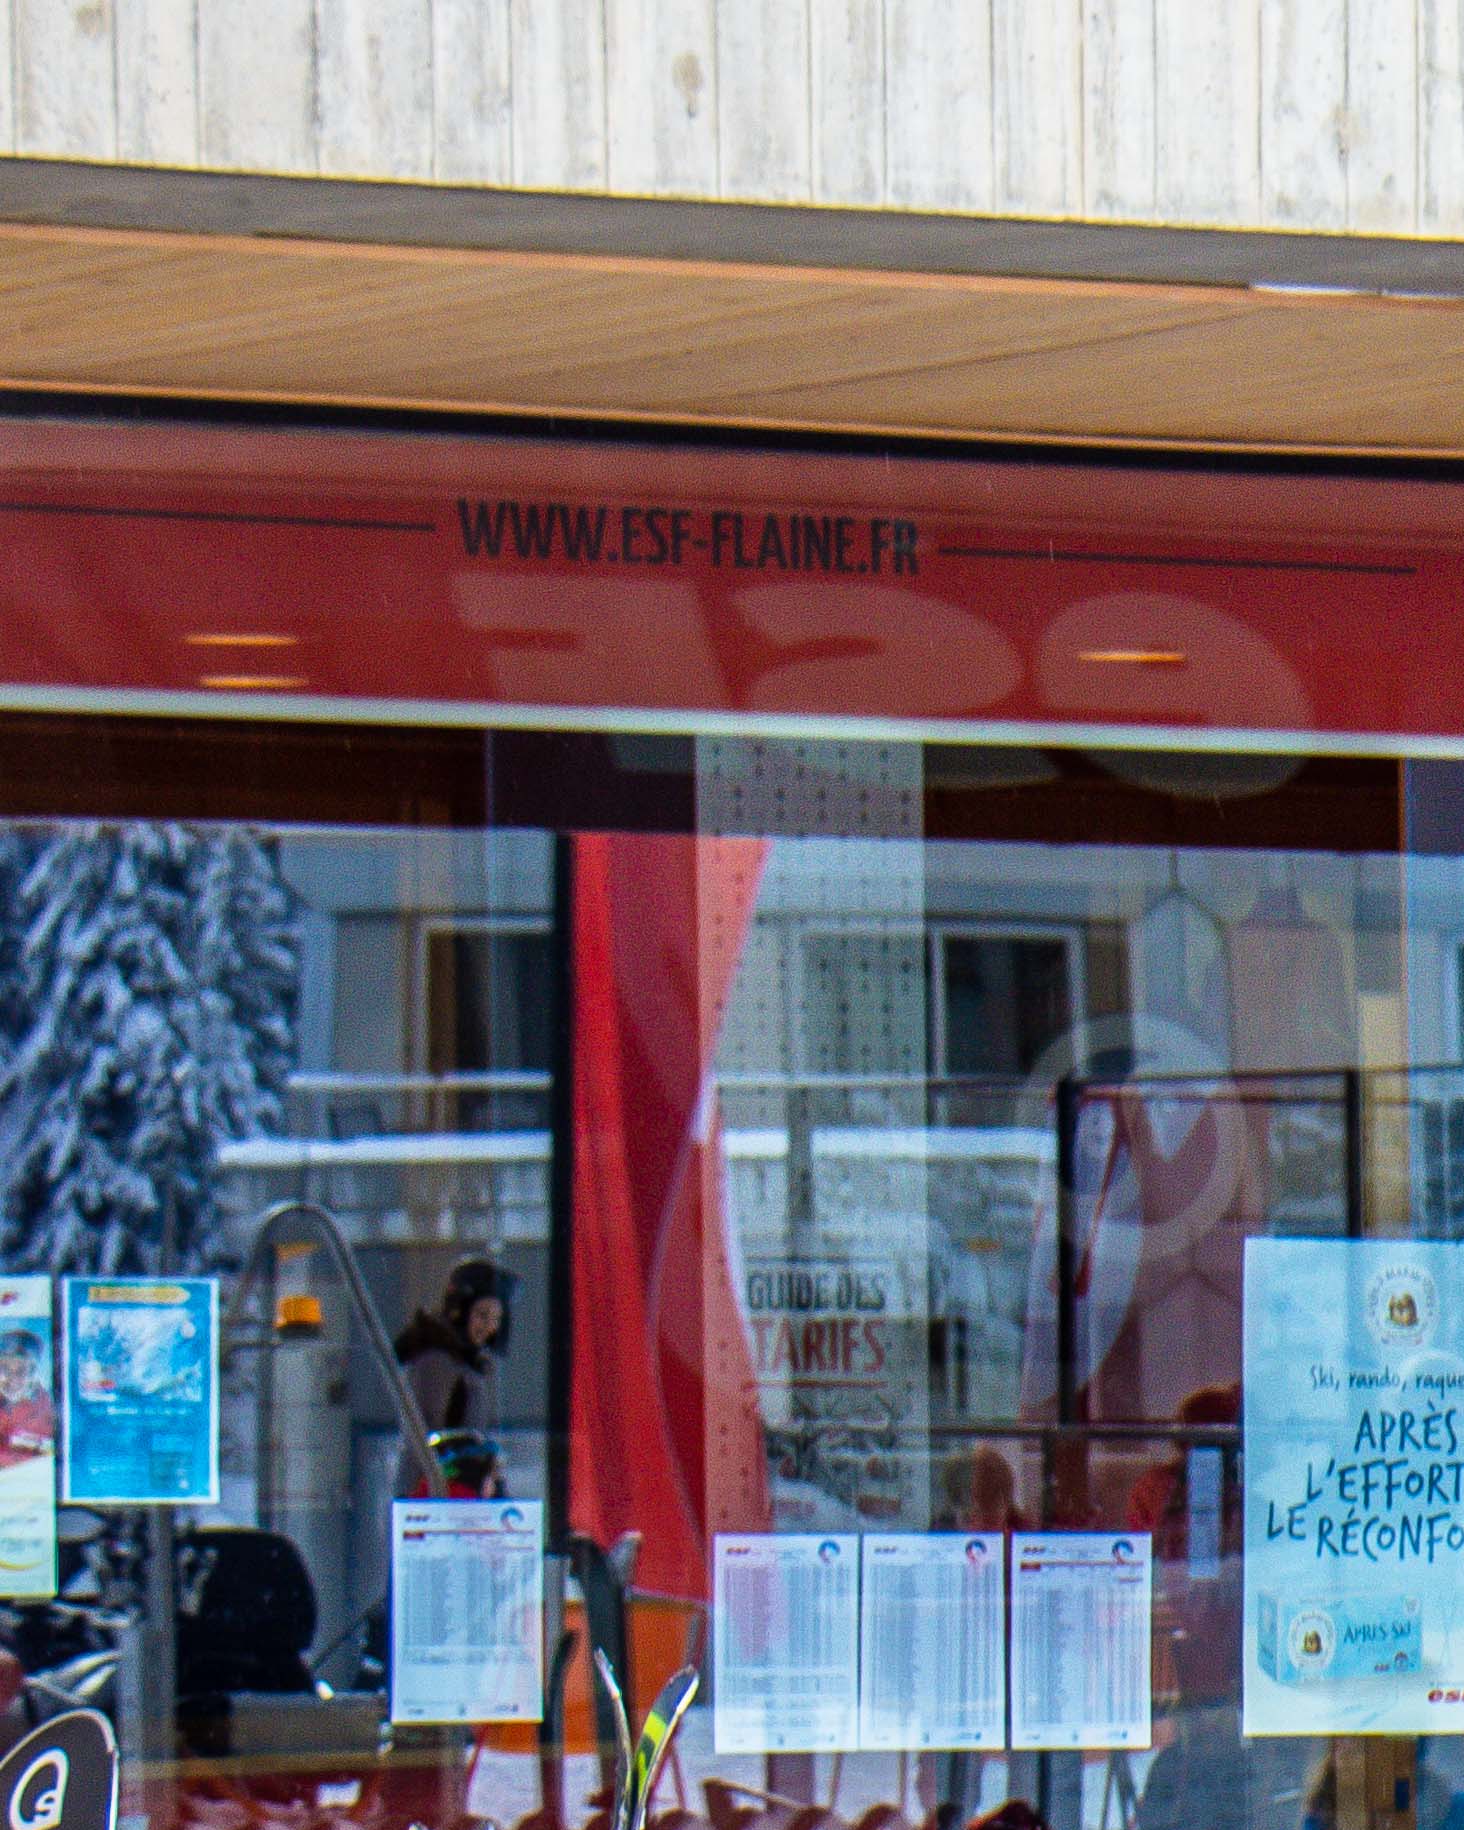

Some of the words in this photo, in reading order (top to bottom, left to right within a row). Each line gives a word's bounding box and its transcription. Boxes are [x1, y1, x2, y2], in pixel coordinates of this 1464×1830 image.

[459, 499, 920, 577] WWW.ESF-FLAINE.FR
[746, 1270, 835, 1312] GUIDE
[752, 1318, 888, 1373] TARIFS
[1354, 1400, 1458, 1454] APRÈS
[1267, 1501, 1307, 1540] LE
